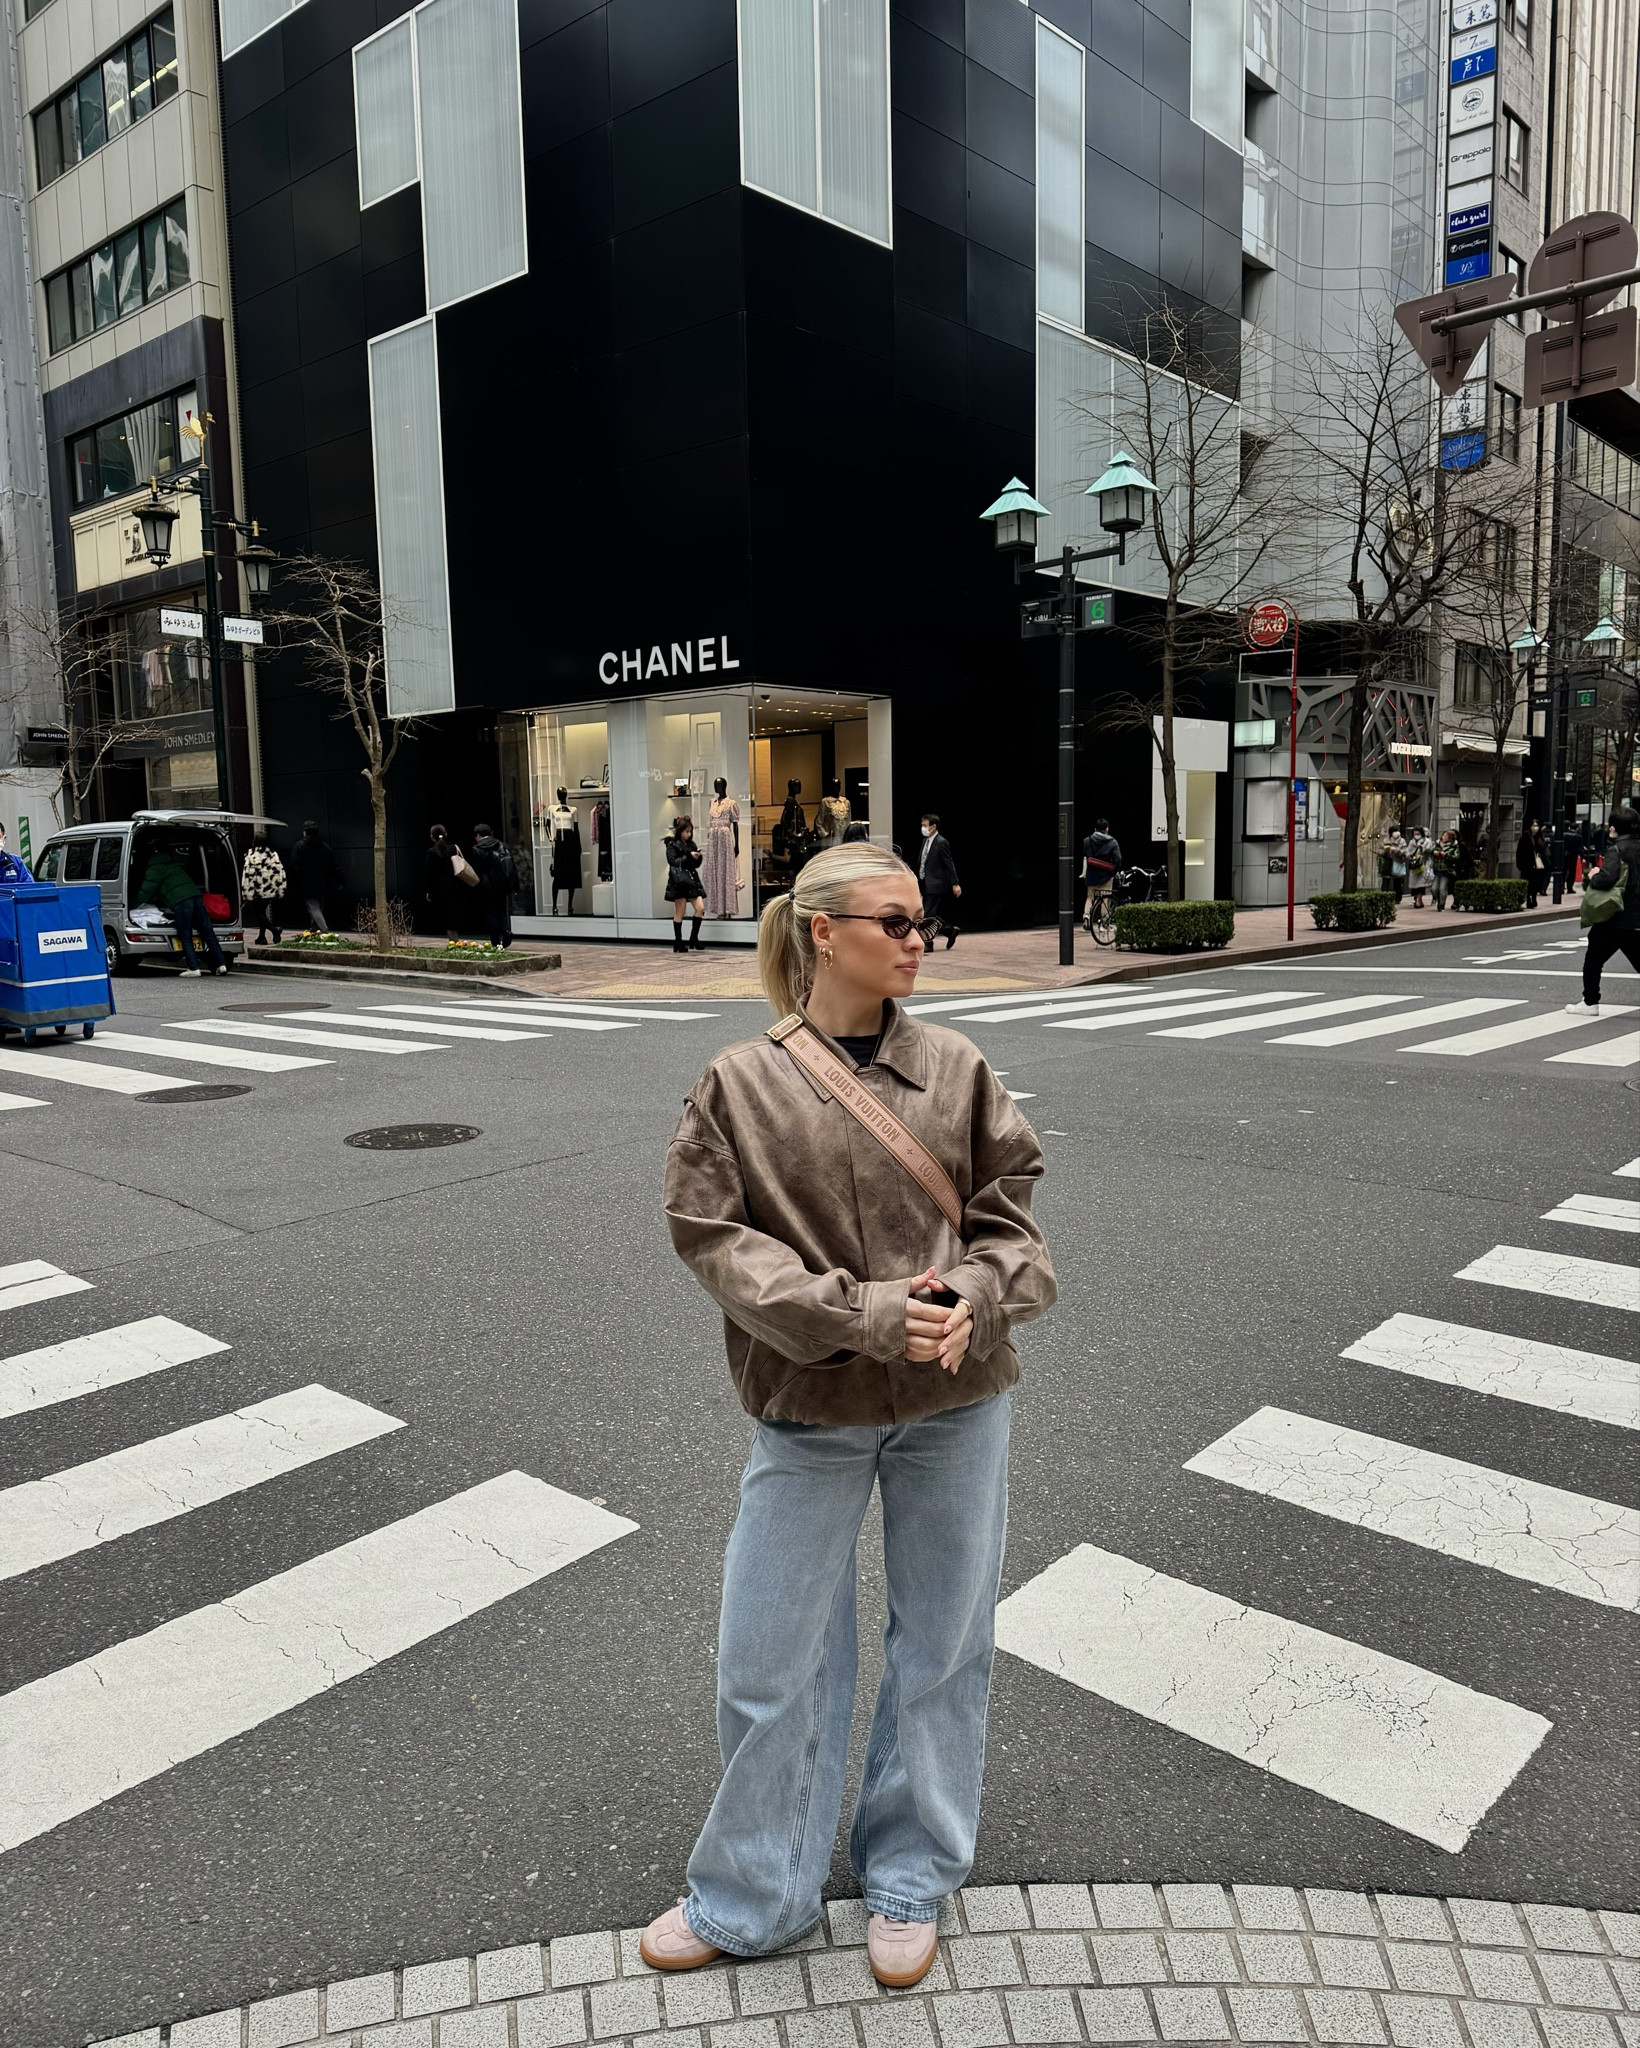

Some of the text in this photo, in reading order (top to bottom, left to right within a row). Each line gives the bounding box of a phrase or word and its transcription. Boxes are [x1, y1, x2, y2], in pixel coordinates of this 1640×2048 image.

[1450, 146, 1492, 163] Grappolo
[1091, 600, 1105, 620] 6
[599, 635, 740, 685] CHANEL
[163, 731, 216, 749] JOHN SMEDLEY
[43, 936, 83, 947] SAGAWA
[823, 1066, 857, 1098] LOUIS
[854, 1094, 901, 1143] VUITTON
